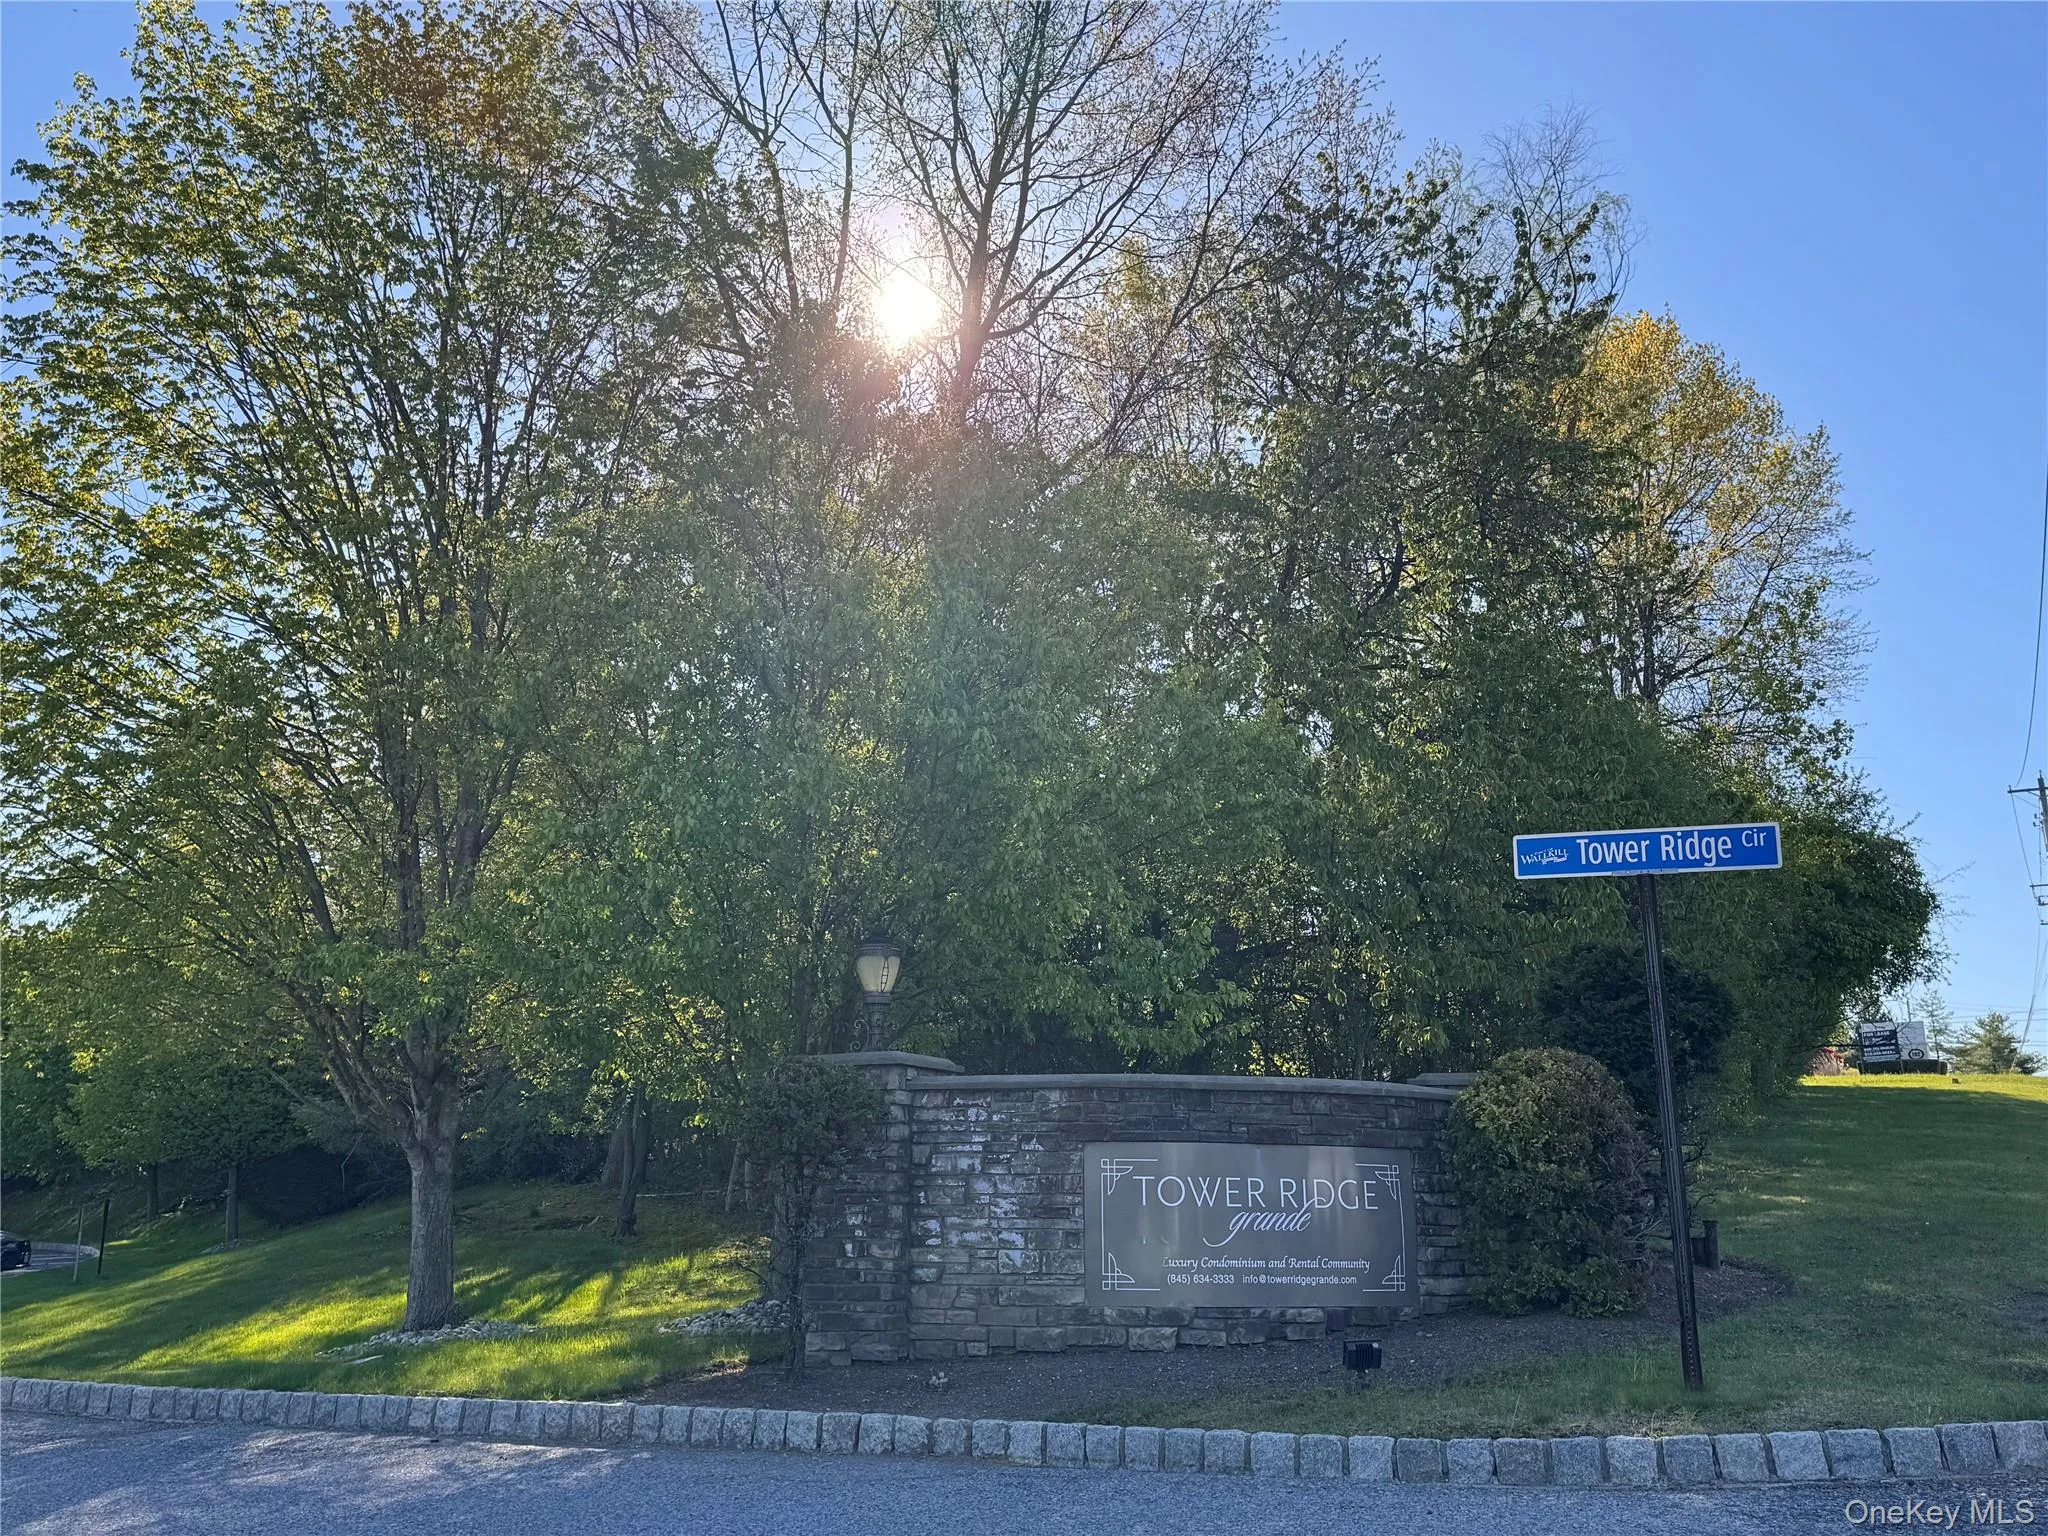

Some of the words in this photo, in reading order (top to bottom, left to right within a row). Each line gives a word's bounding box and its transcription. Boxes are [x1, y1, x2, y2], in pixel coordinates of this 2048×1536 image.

[1576, 838, 1650, 865] Tower
[1660, 831, 1732, 867] Ridge
[1741, 829, 1767, 848] Cir
[1133, 1175, 1266, 1208] TOWER
[1280, 1178, 1379, 1210] RIDGE
[1202, 1197, 1327, 1247] grande
[1162, 1256, 1199, 1273] Luxury
[1201, 1255, 1266, 1268] Condominium
[1268, 1255, 1288, 1268] and
[1289, 1255, 1321, 1269] Rental
[1321, 1257, 1370, 1273] Community
[1167, 1274, 1191, 1285] (845)
[1193, 1274, 1234, 1284] 634-3333
[1242, 1274, 1357, 1286] info@towerridgegrande.com
